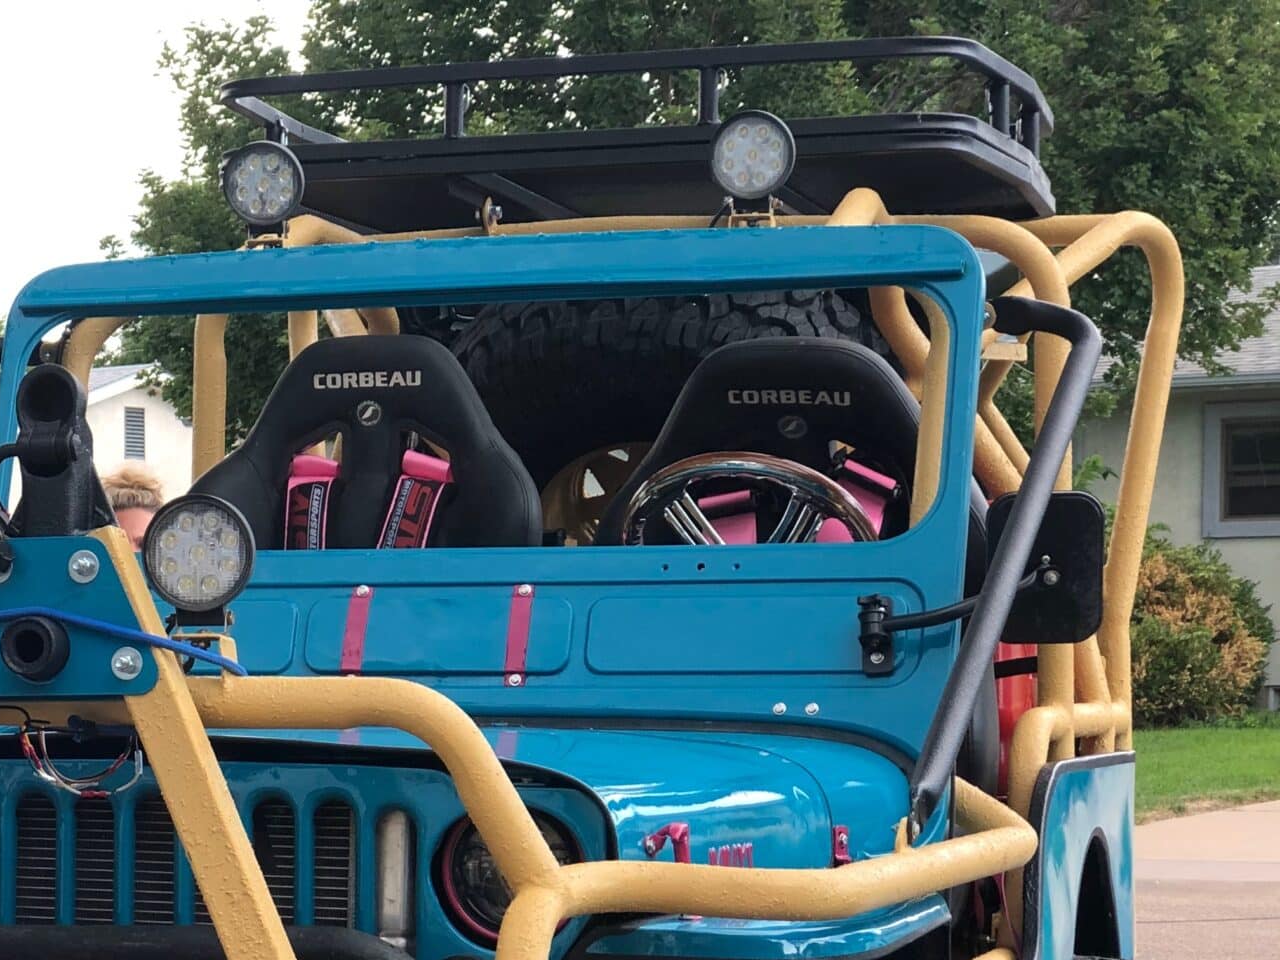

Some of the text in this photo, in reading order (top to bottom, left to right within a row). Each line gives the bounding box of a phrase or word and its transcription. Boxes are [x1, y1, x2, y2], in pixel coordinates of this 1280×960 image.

[313, 371, 421, 389] CORBEAU
[727, 389, 852, 406] CORBEAU
[309, 488, 322, 550] TORSPORTS
